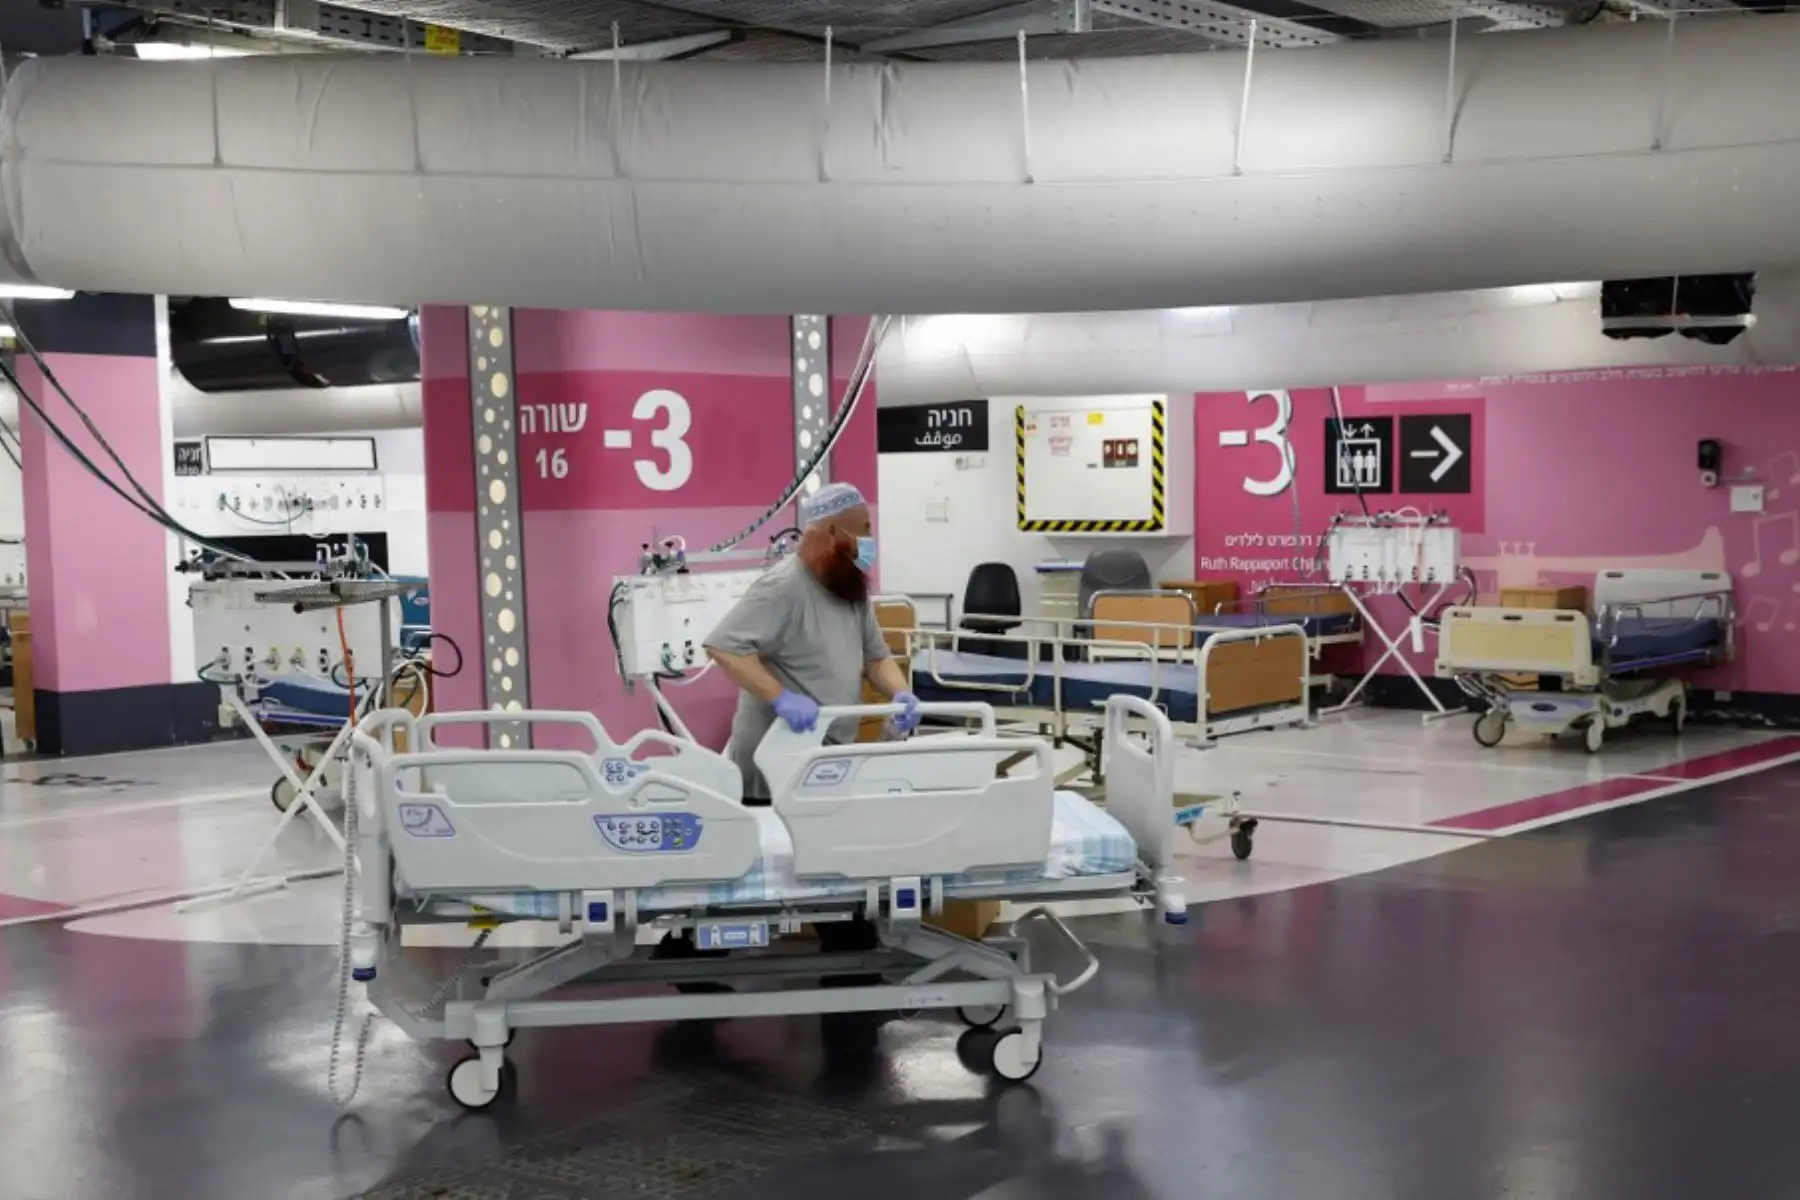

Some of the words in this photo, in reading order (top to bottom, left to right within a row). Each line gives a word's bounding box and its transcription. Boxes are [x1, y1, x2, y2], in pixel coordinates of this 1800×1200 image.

[520, 403, 588, 434] שורה
[928, 408, 972, 428] חניה
[603, 389, 693, 491] -3
[914, 430, 962, 449] موقف
[1219, 389, 1296, 495] -3
[535, 448, 568, 479] 16
[1200, 556, 1228, 570] Ruth
[1229, 556, 1288, 573] Rappaport
